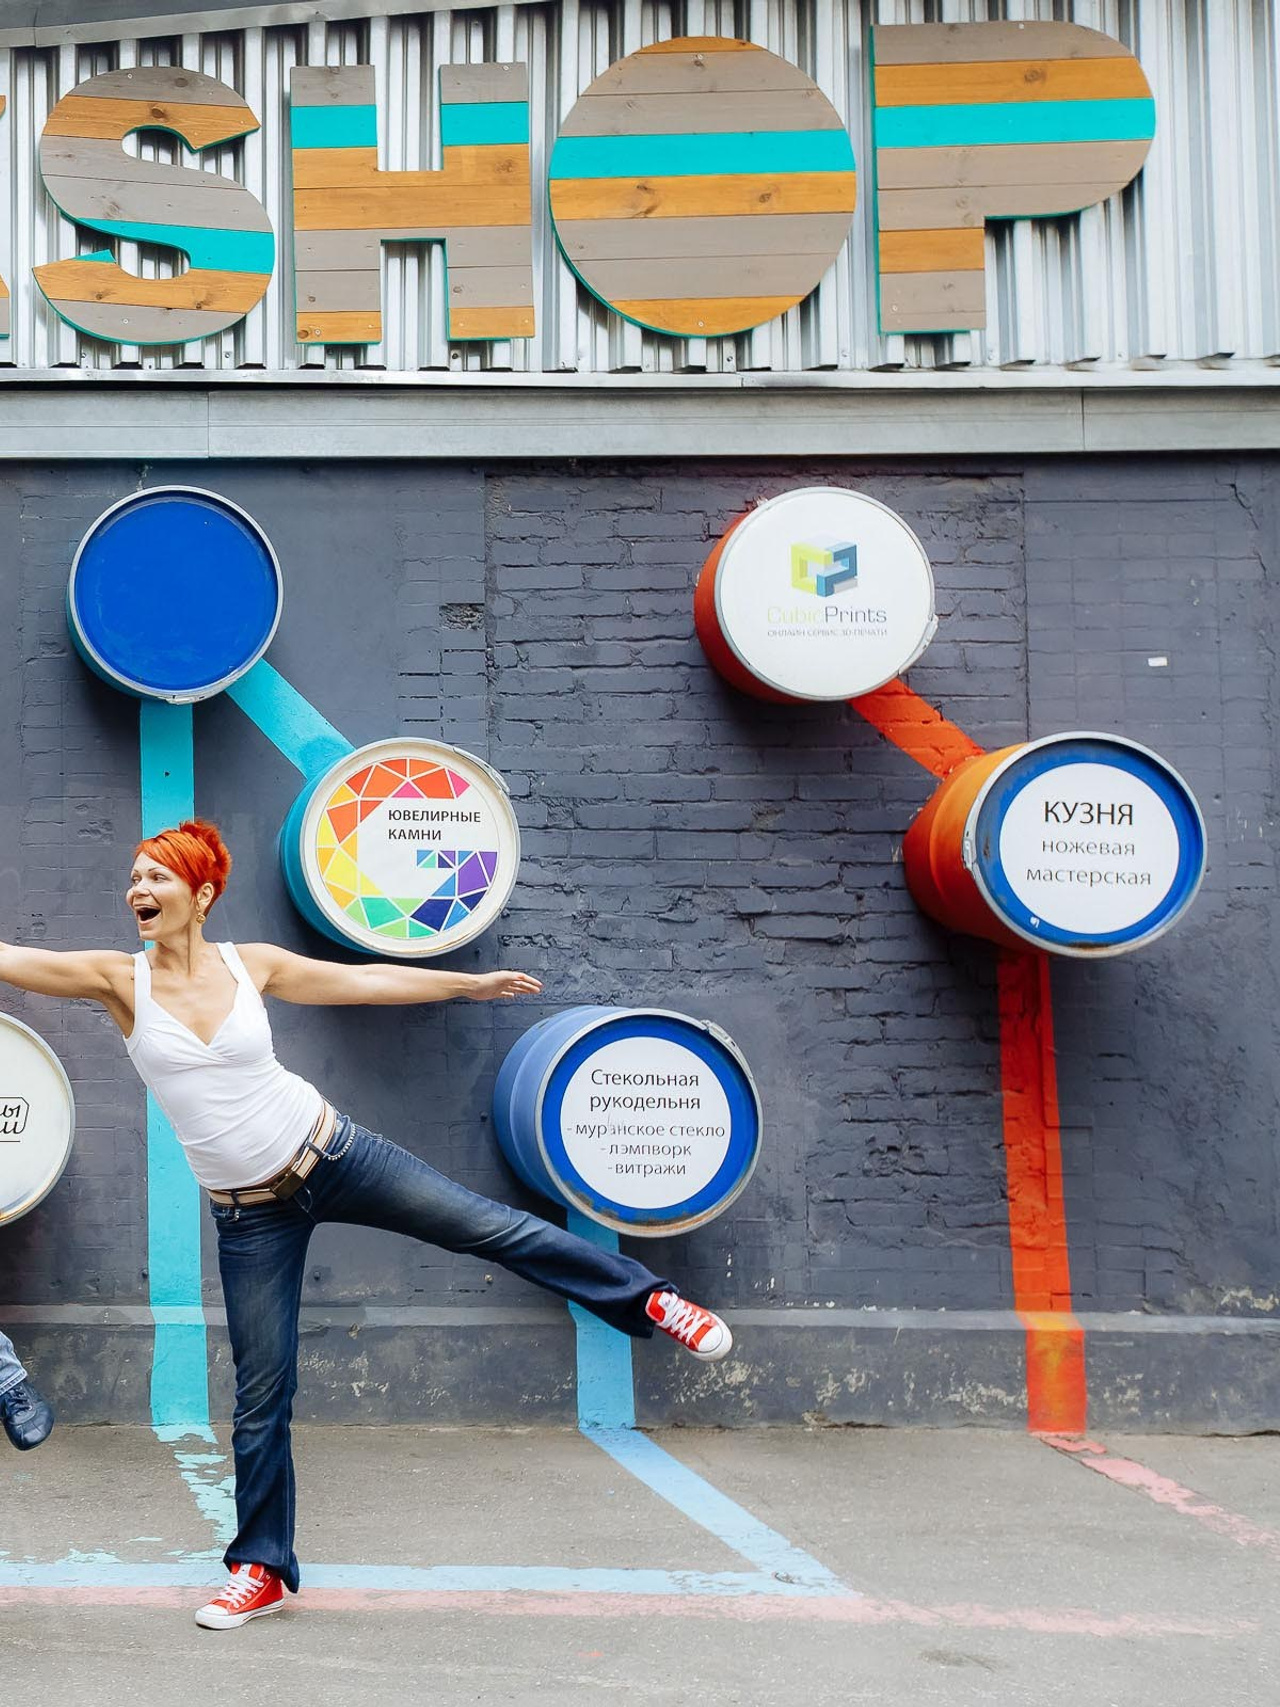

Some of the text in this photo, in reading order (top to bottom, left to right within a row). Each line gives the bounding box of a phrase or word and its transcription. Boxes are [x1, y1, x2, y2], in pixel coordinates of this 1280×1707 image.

[388, 809, 481, 823] ЮВЕЛИРНЫЕ
[1044, 800, 1133, 826] КУЗНЯ
[388, 828, 442, 840] КАМНИ
[1042, 840, 1136, 856] ножевая
[1026, 867, 1152, 888] мастерская
[591, 1069, 699, 1086] Стекольная
[589, 1096, 701, 1111] рукодельня
[669, 1126, 725, 1138] стекло
